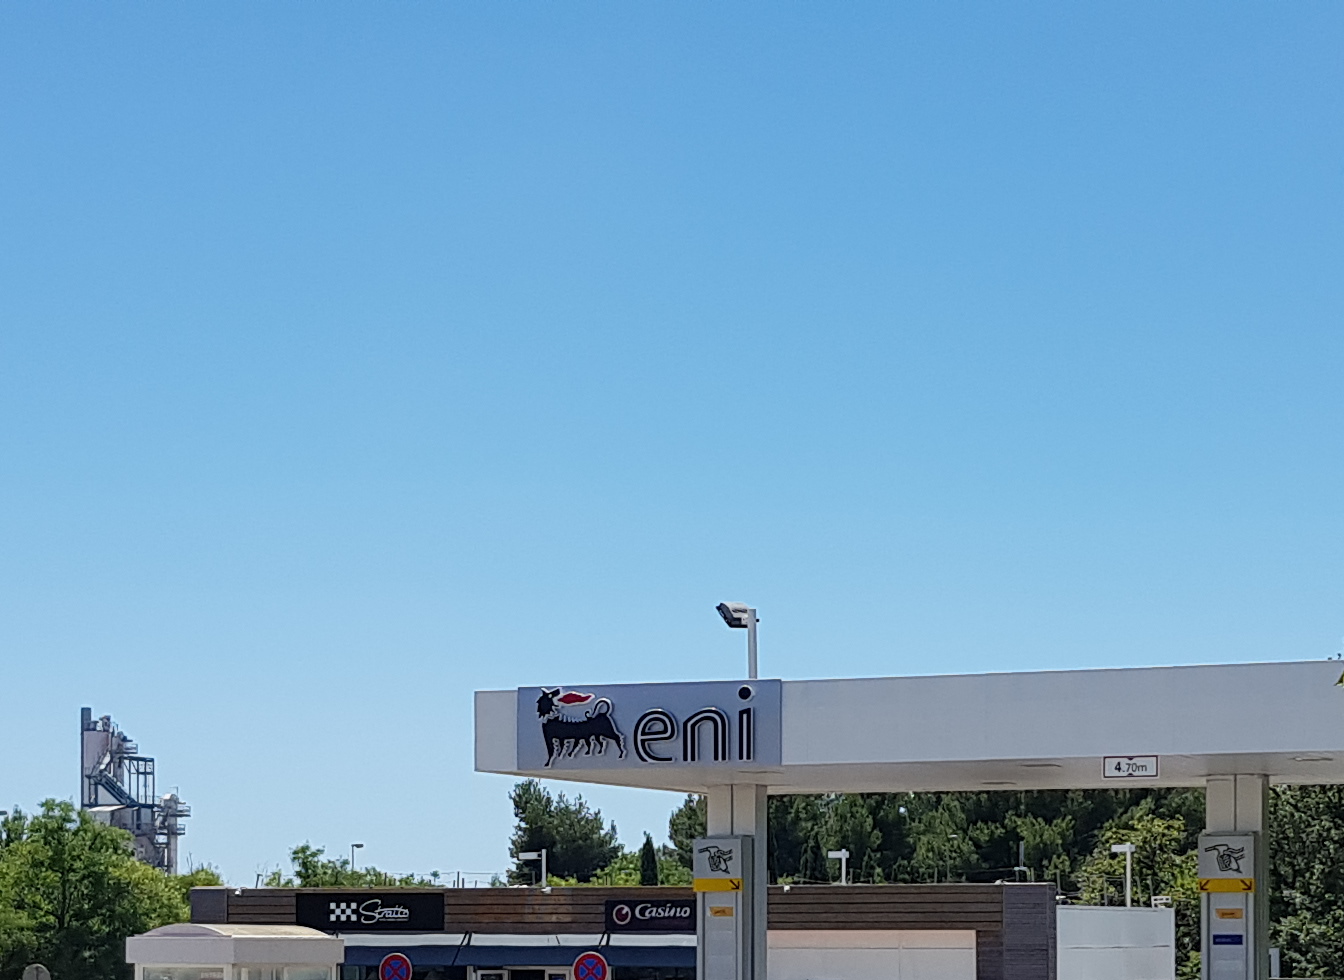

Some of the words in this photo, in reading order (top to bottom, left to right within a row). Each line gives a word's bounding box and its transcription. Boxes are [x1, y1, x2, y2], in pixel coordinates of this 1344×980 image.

[633, 684, 755, 763] eni
[1114, 761, 1148, 773] 4.70m
[635, 903, 691, 920] Casino
